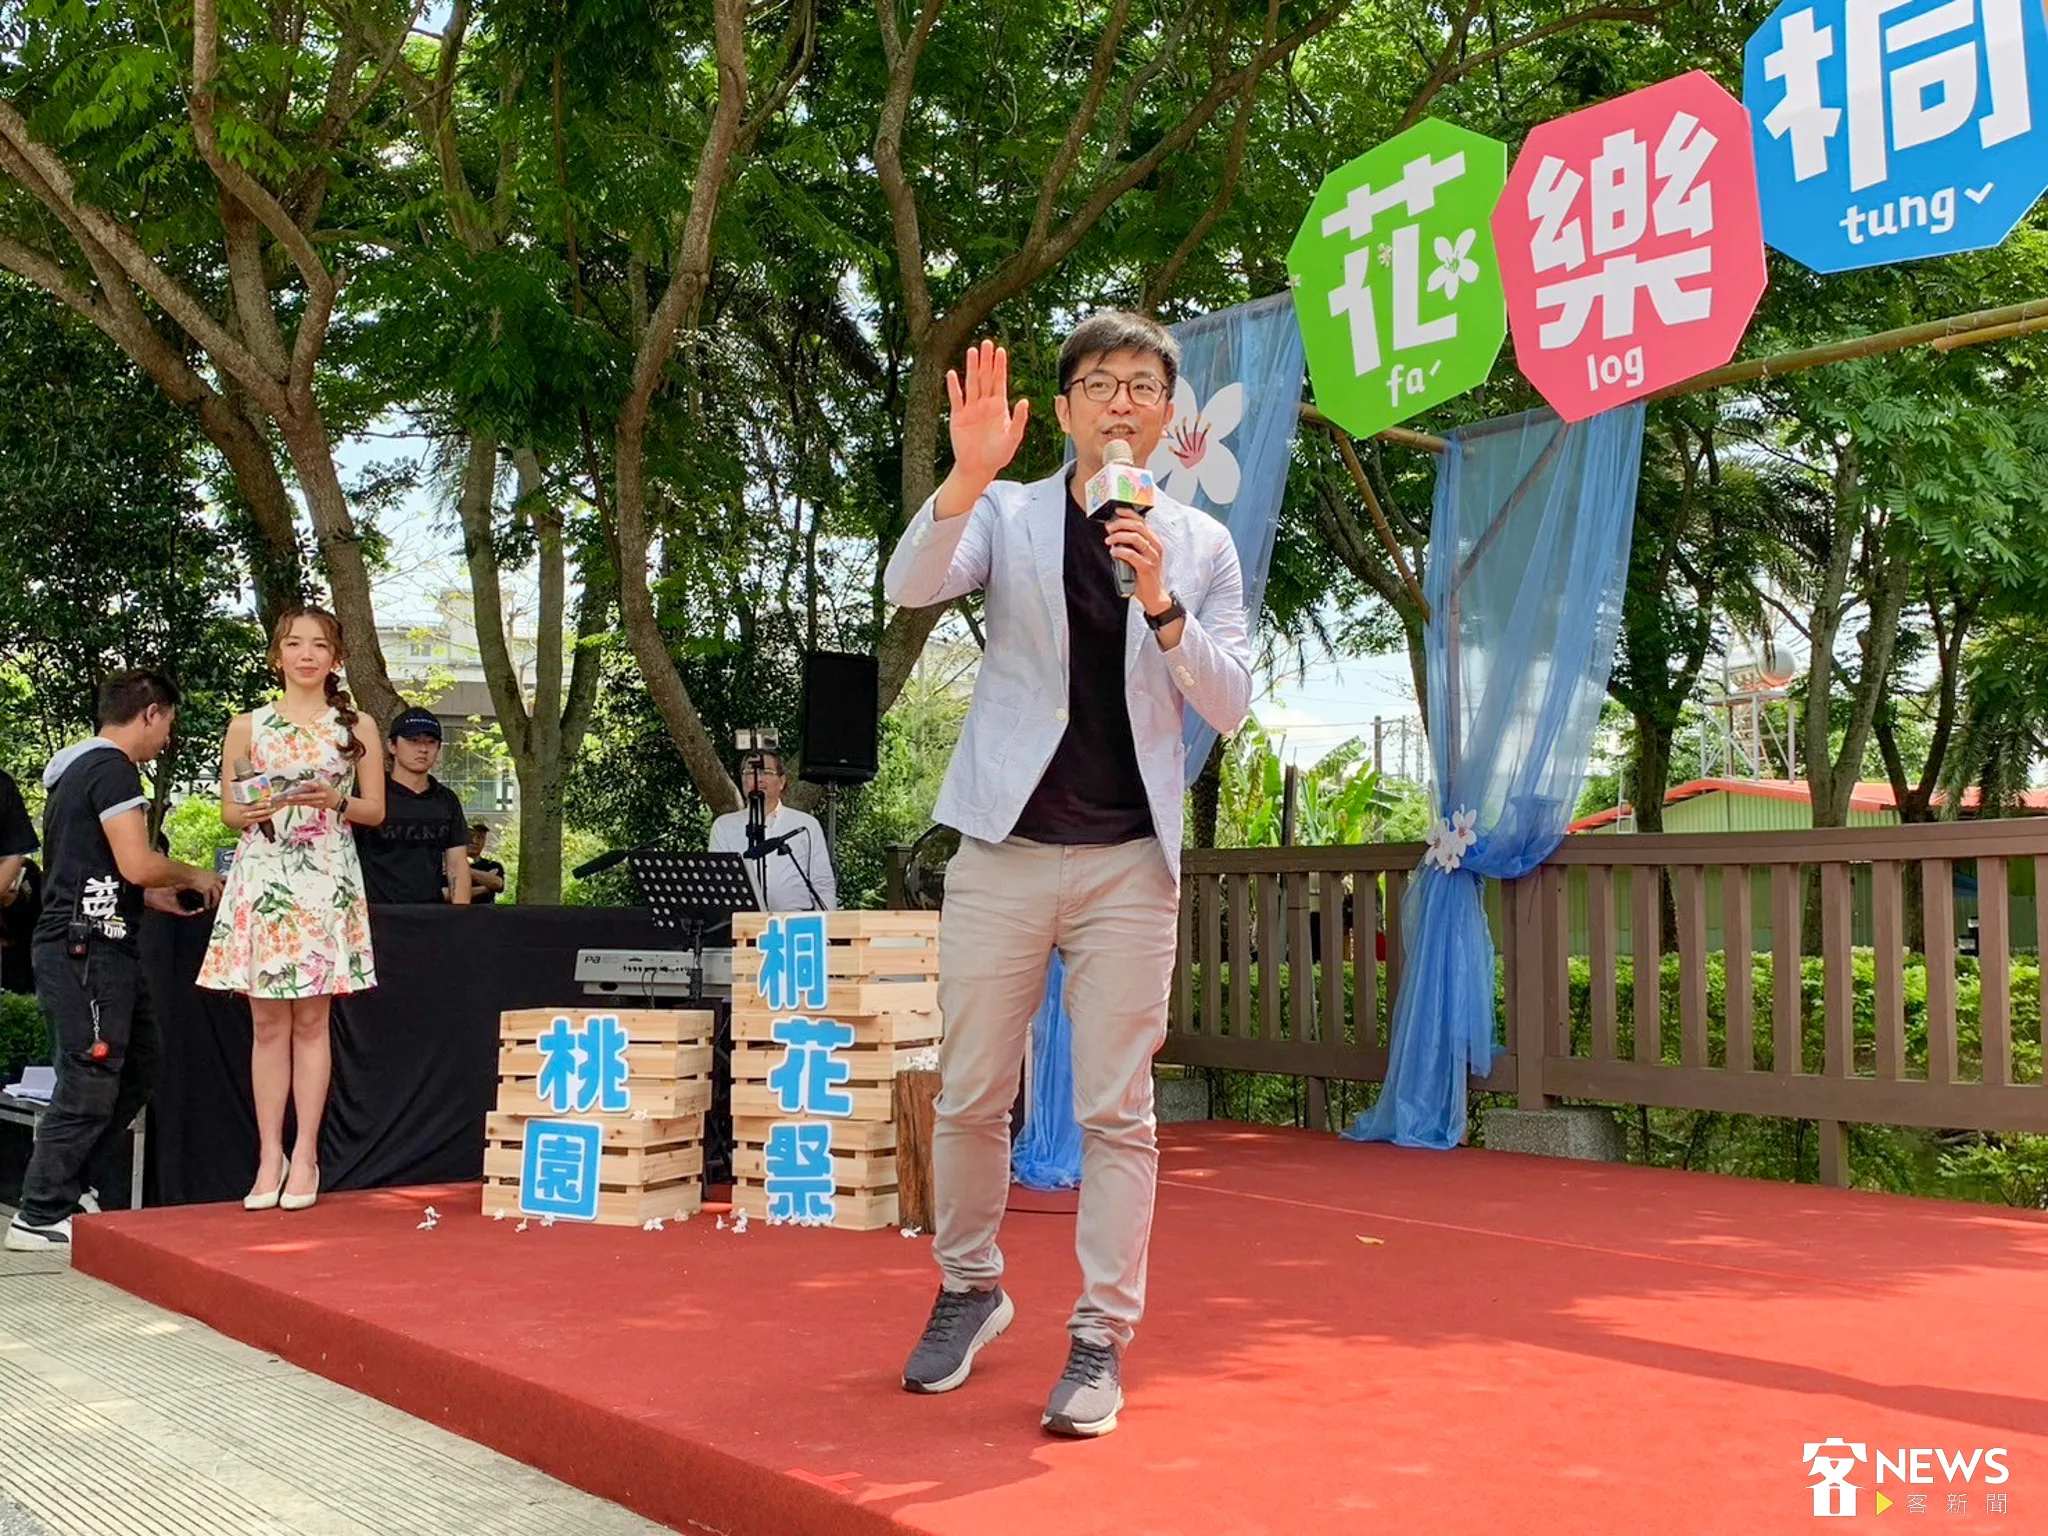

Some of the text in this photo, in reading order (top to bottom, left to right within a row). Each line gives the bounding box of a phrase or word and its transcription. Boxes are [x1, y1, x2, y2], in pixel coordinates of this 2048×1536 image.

[1764, 0, 2032, 193] 桐
[1321, 150, 1480, 379] 花
[1525, 110, 1719, 351] 樂
[1586, 346, 1645, 393] log
[519, 1014, 630, 1221] 桃園
[757, 911, 855, 1227] 桐花祭
